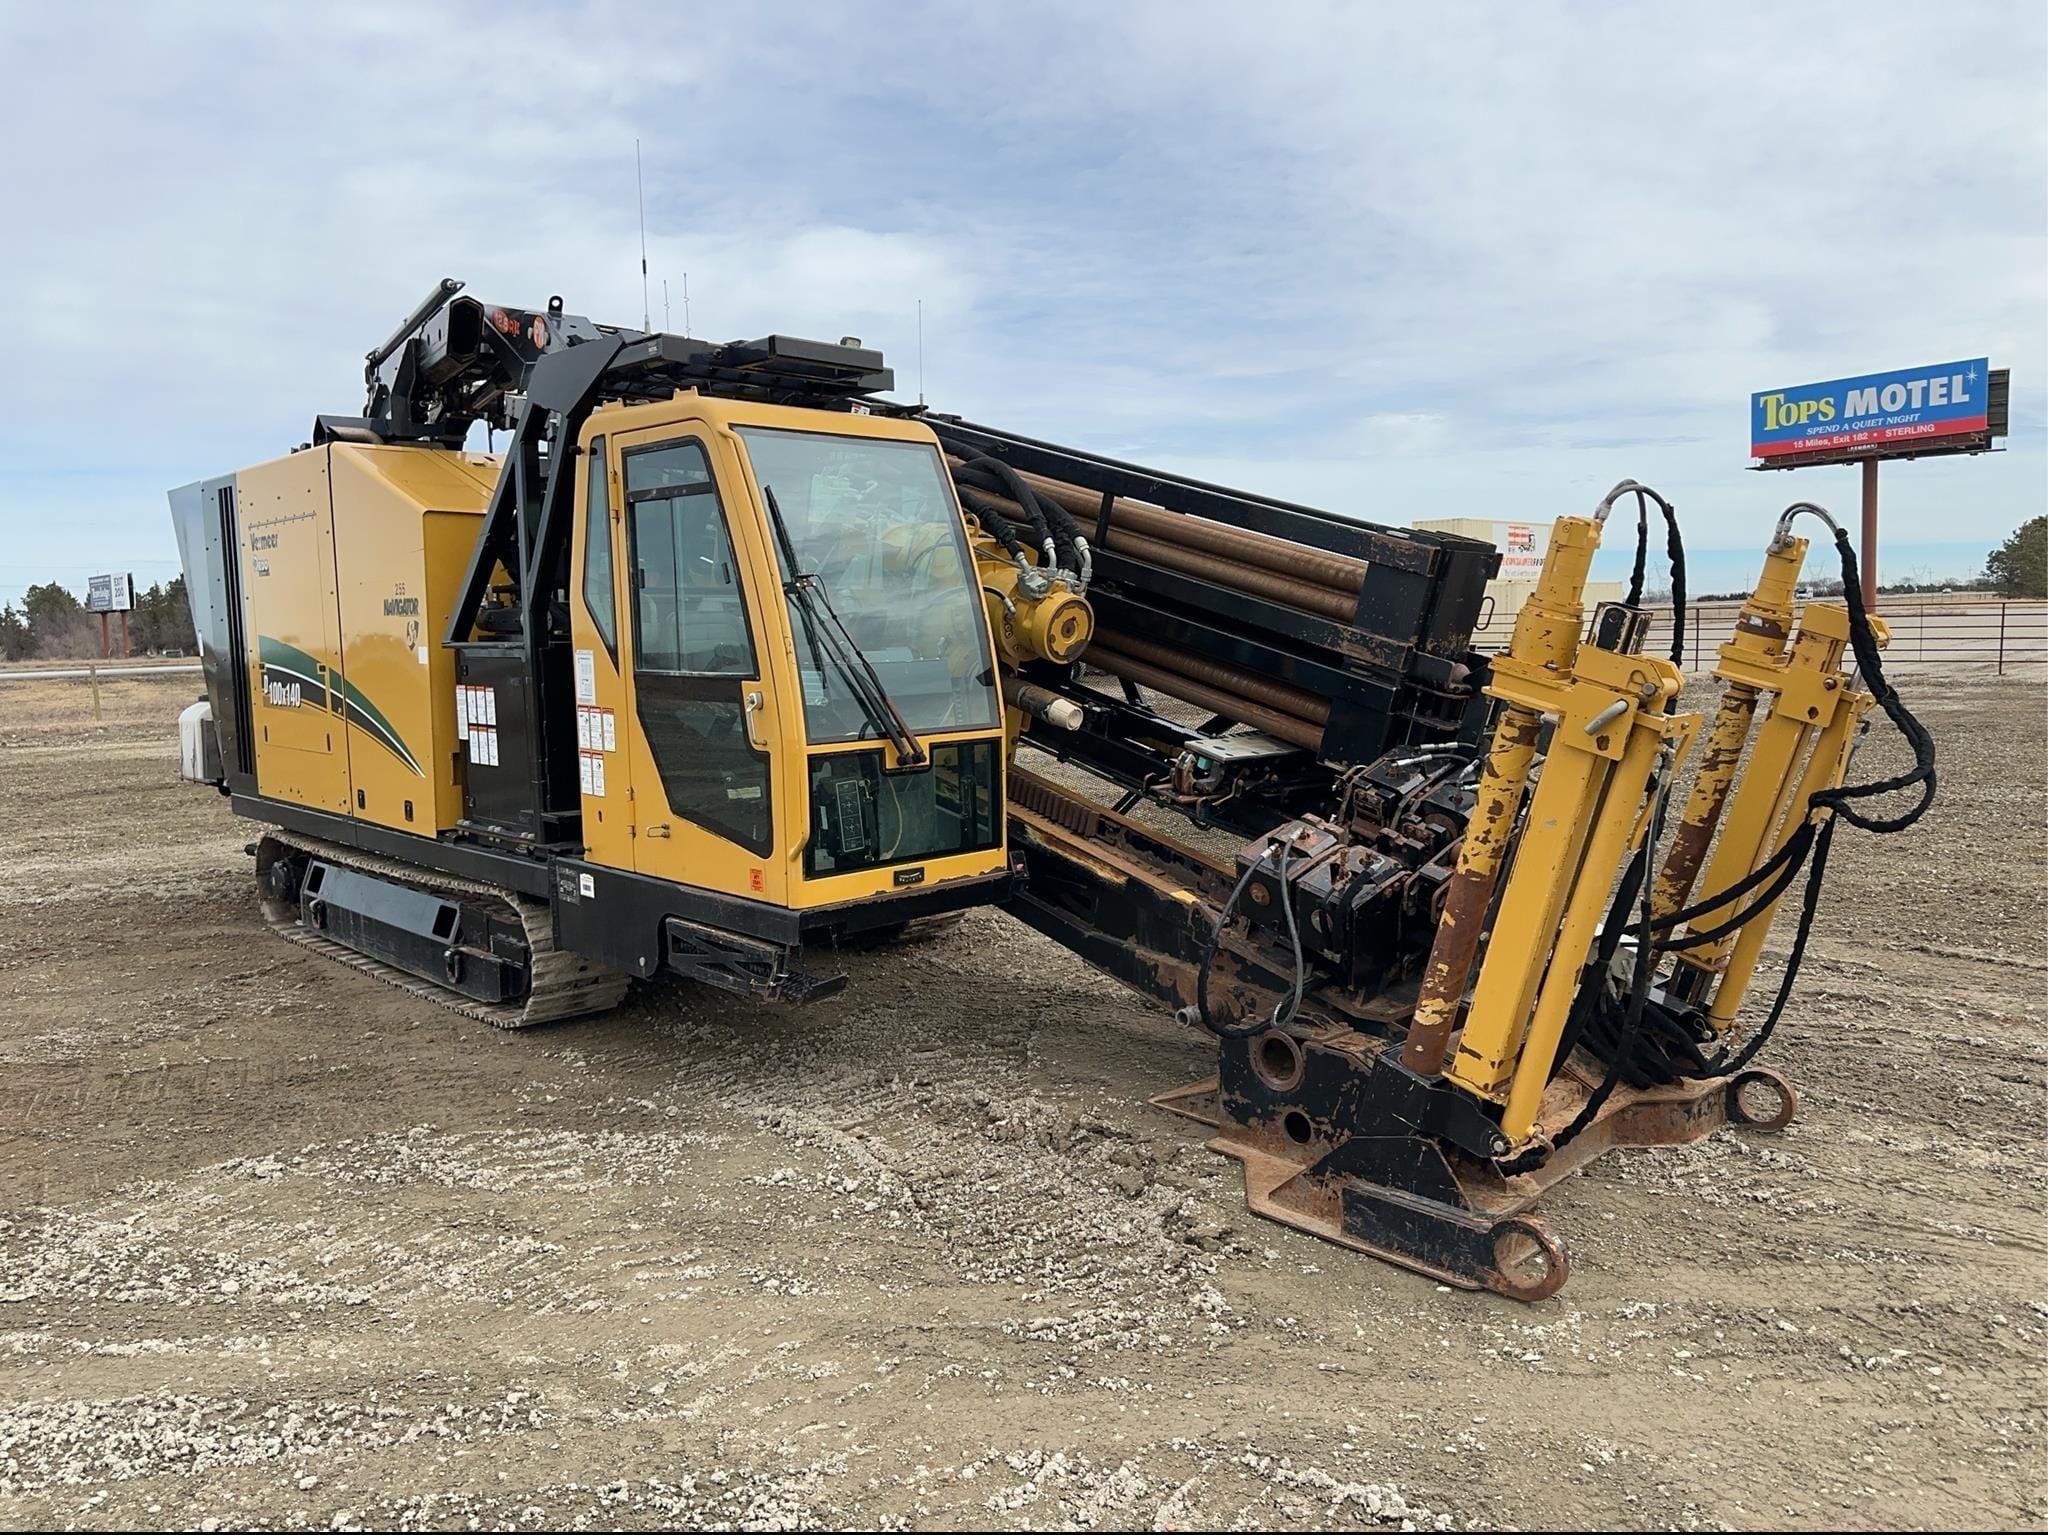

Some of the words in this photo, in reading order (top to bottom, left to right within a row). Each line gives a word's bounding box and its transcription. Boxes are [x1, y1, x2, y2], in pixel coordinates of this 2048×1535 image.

[1843, 374, 1970, 419] MOTEL
[1793, 440, 1804, 449] 15
[1833, 435, 1850, 444] Exit
[1852, 432, 1869, 442] 182
[1885, 423, 1935, 438] STERLING
[1806, 425, 1840, 436] SPEND
[1841, 423, 1850, 432] A
[1852, 417, 1885, 430] QUIET
[1886, 412, 1921, 426] NIGHT
[394, 582, 406, 596] 255
